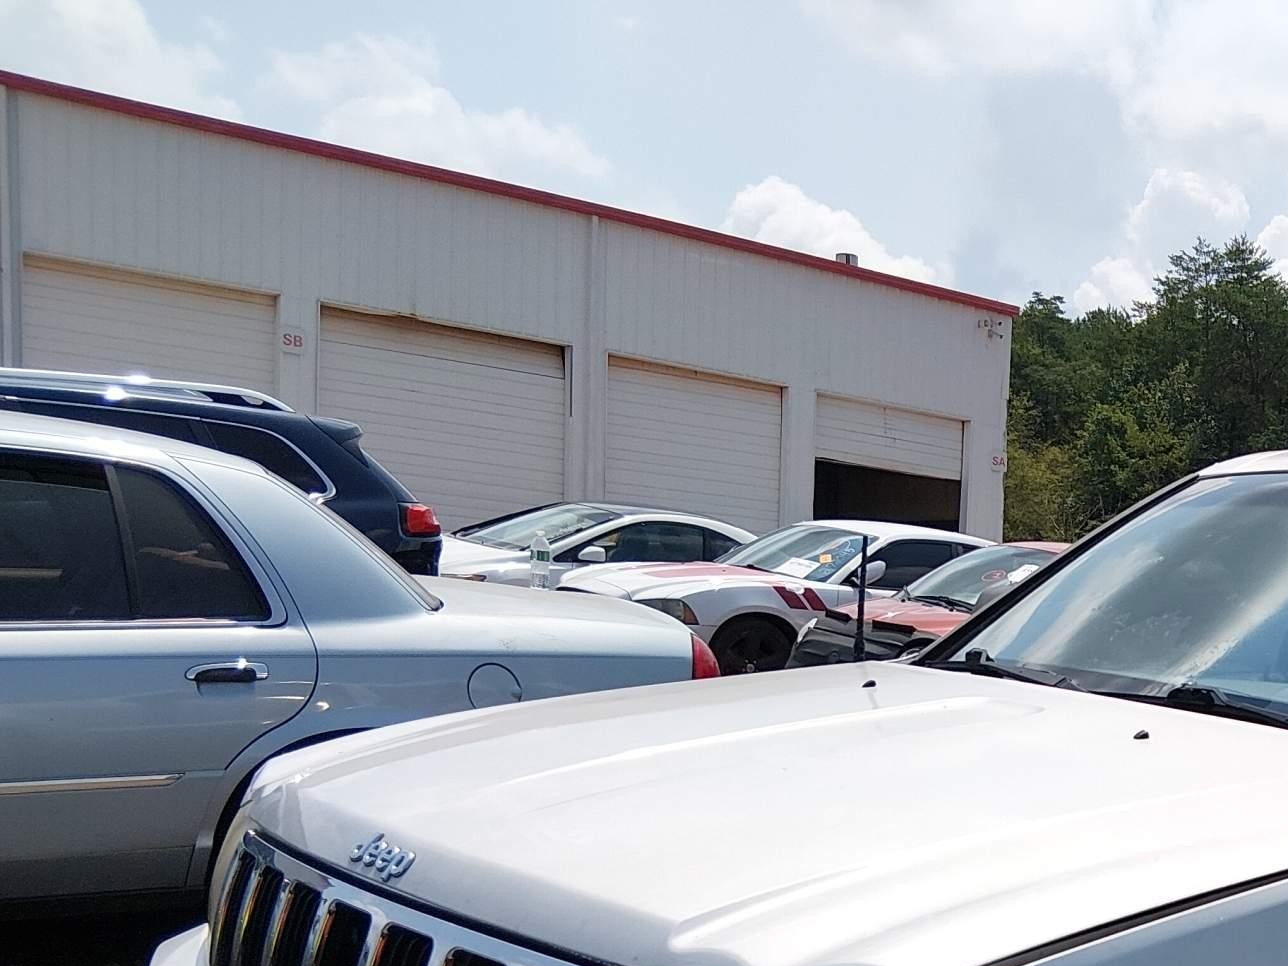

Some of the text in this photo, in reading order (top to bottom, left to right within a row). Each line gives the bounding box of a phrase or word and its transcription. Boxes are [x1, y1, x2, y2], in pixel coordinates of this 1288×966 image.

[282, 333, 304, 348] SB
[991, 455, 1006, 468] SA
[349, 832, 416, 882] Jeep
